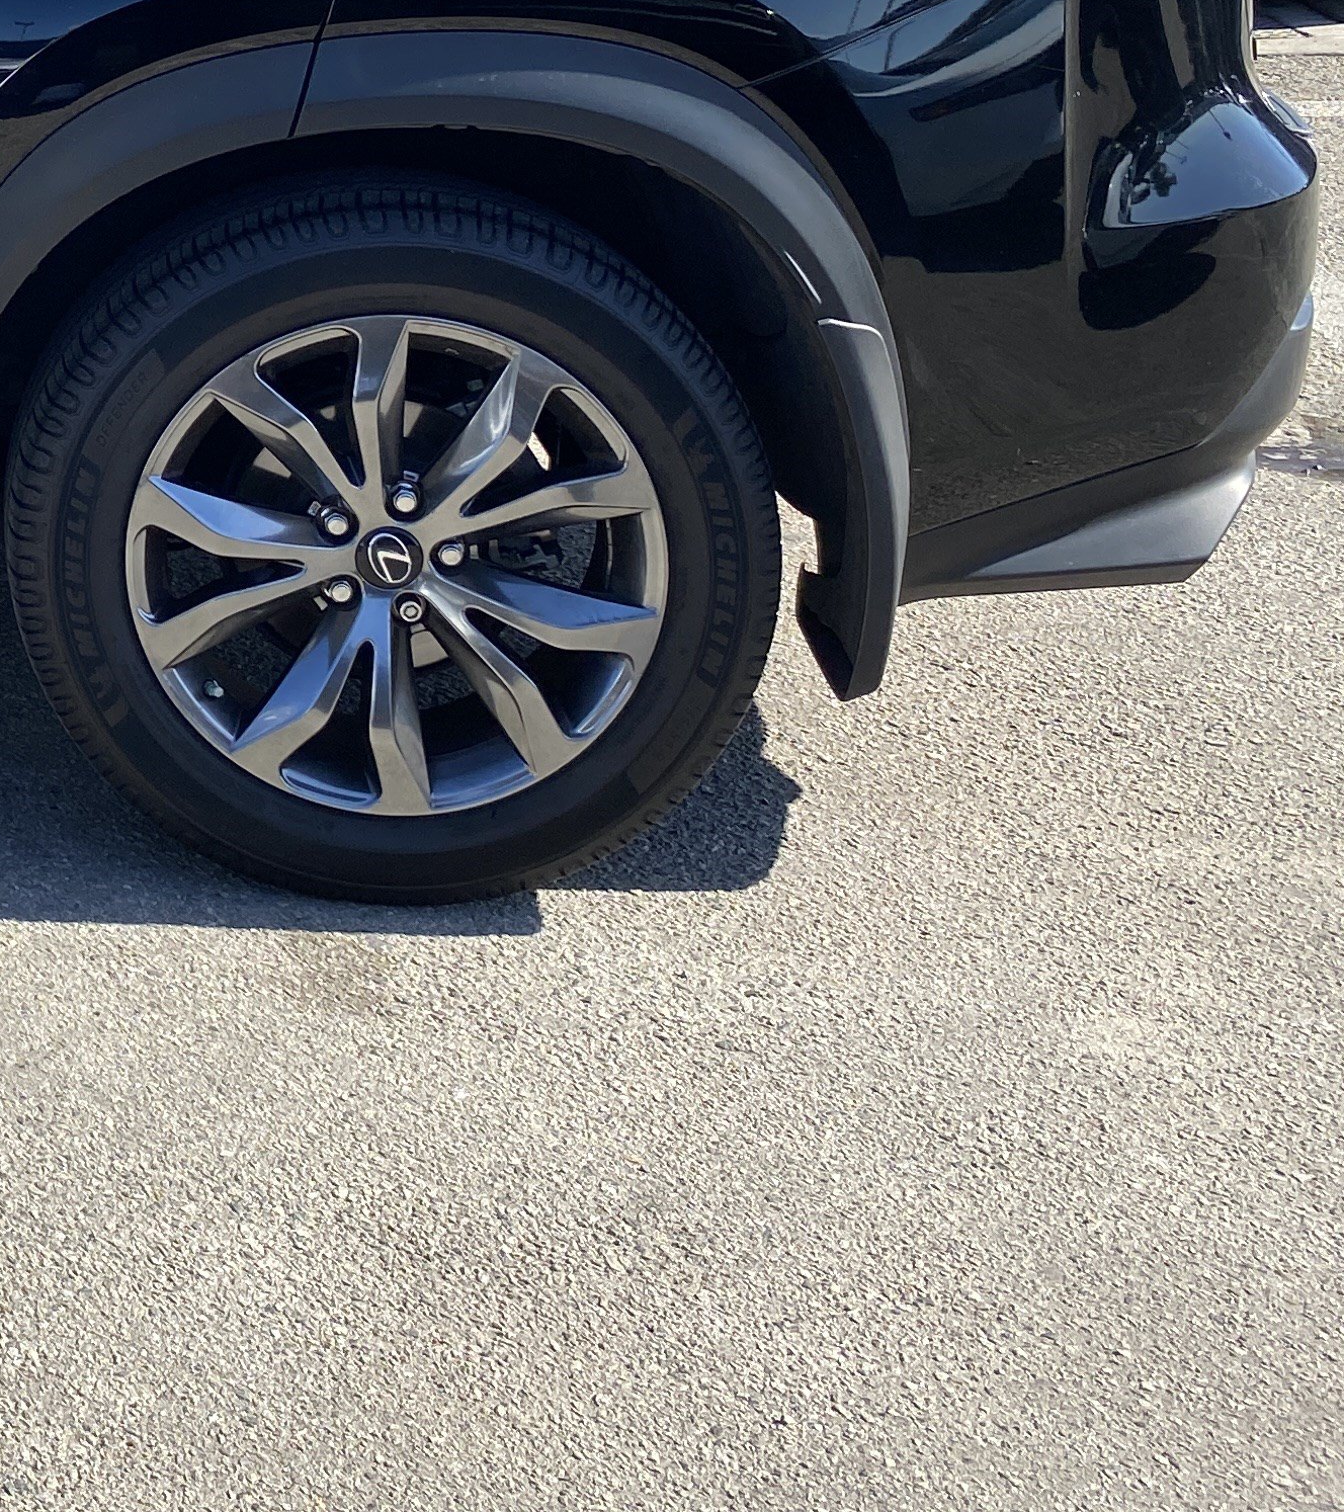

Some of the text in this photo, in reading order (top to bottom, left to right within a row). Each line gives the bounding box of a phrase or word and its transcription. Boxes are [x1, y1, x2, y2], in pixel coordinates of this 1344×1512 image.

[95, 371, 149, 450] DEFENDER
[63, 465, 100, 660] MICHELIN
[700, 480, 739, 679] MICHELIN
